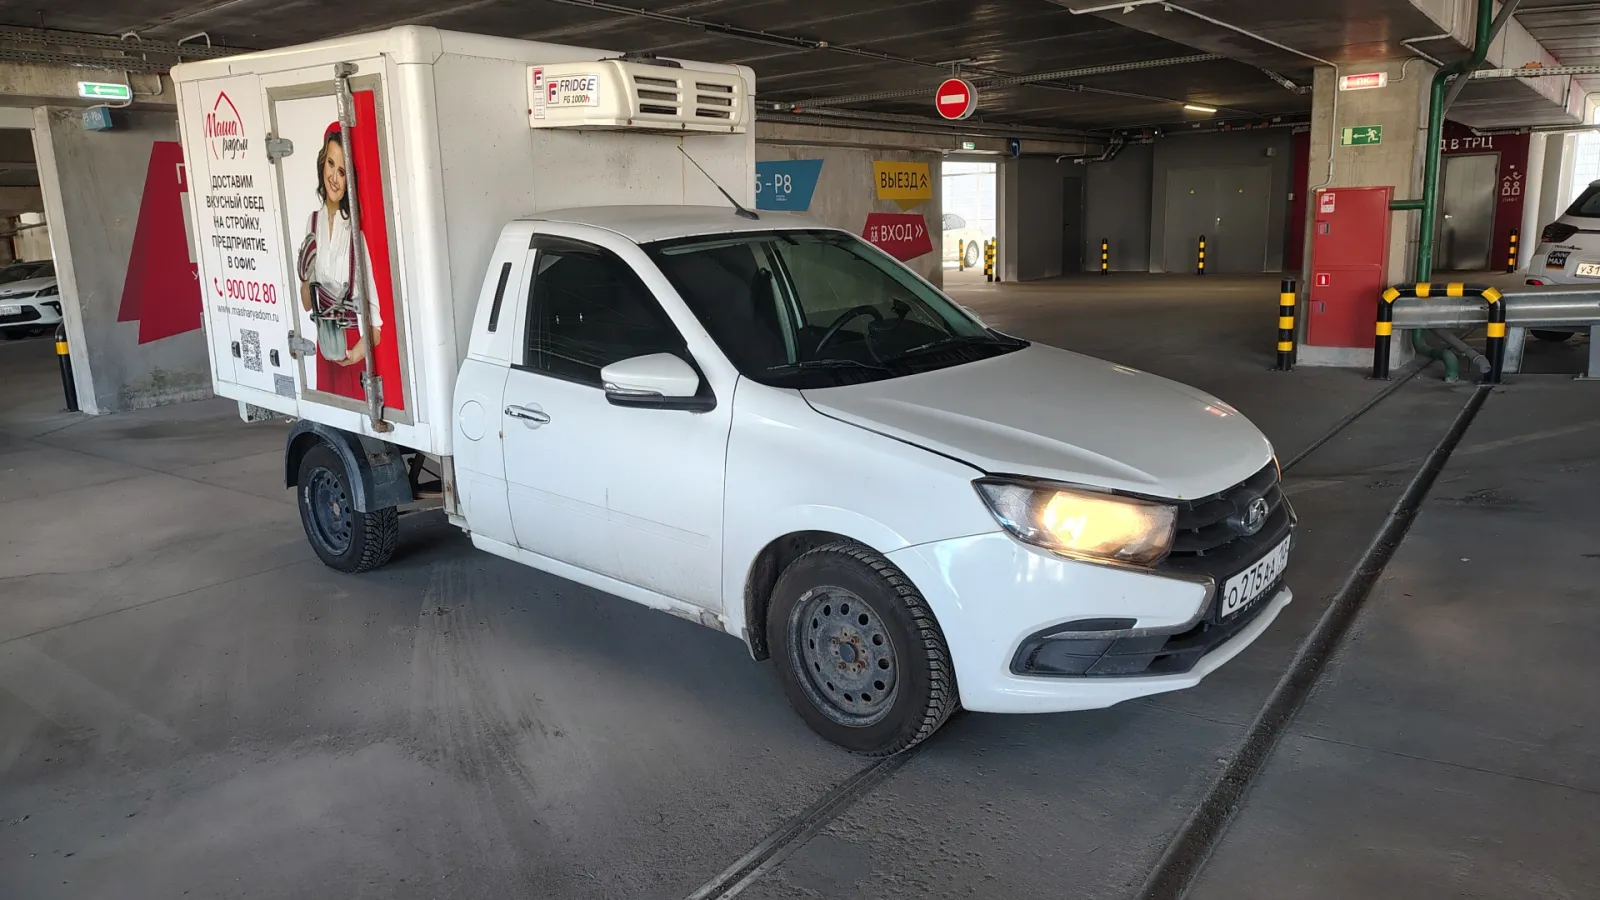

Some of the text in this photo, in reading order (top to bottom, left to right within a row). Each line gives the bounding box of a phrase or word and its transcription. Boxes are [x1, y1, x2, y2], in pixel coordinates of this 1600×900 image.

[560, 78, 595, 92] FRIDGE
[1357, 77, 1370, 86] ПК
[563, 94, 590, 103] FG 1000h
[205, 113, 237, 138] Маша
[223, 137, 248, 160] рядом
[1451, 139, 1459, 149] В
[1463, 136, 1493, 149] ТРЦ
[212, 175, 253, 190] ДОСТАВИМ
[881, 172, 918, 190] ВЫЕЗД
[206, 193, 265, 212] ВКУСНЫЙ ОБЕД
[213, 214, 262, 233] НА СТРОЙКУ,
[881, 223, 913, 241] ВХОД
[212, 235, 268, 254] ПРЕДПРИЯТИЕ,
[228, 256, 256, 271] В ОФИС
[1548, 257, 1564, 265] MAX
[226, 278, 277, 304] 900 02 80
[217, 305, 279, 322] www.masharyadom.ru
